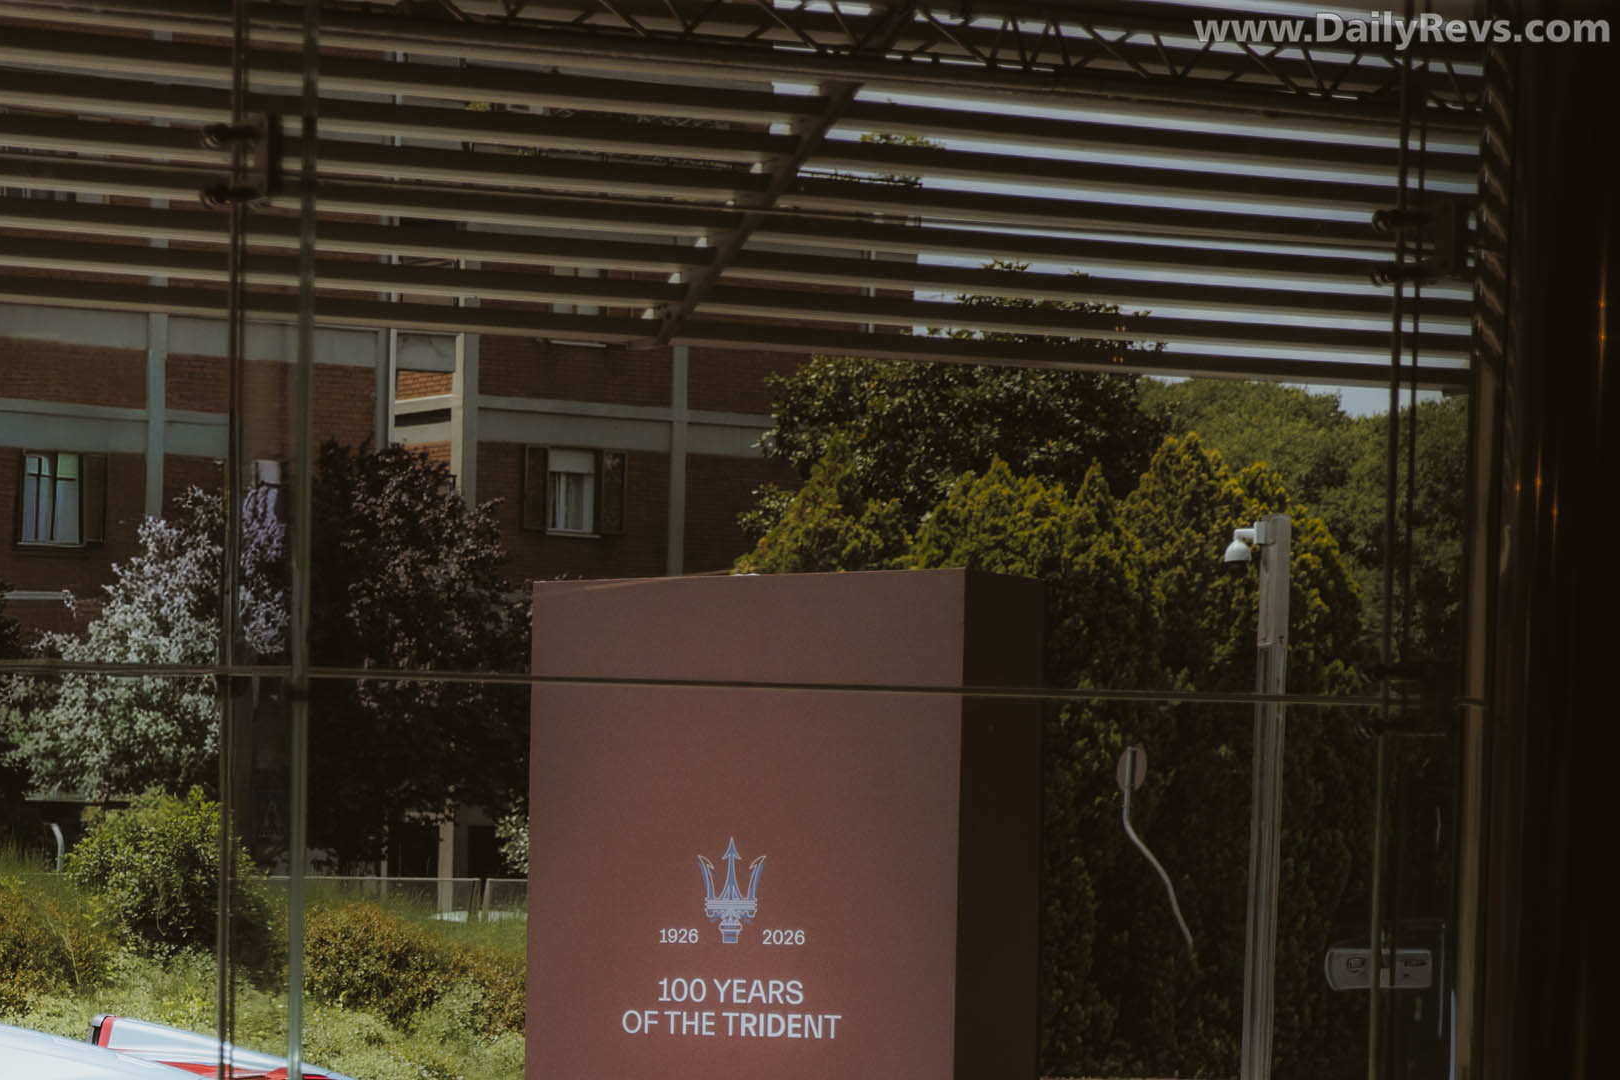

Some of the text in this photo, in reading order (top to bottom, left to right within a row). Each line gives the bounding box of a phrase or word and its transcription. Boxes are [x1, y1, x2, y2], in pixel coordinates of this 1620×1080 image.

[659, 928, 805, 945] 1926 2026
[658, 978, 804, 1005] 100 YEARS
[622, 1010, 842, 1039] OF THE TRIDENT
